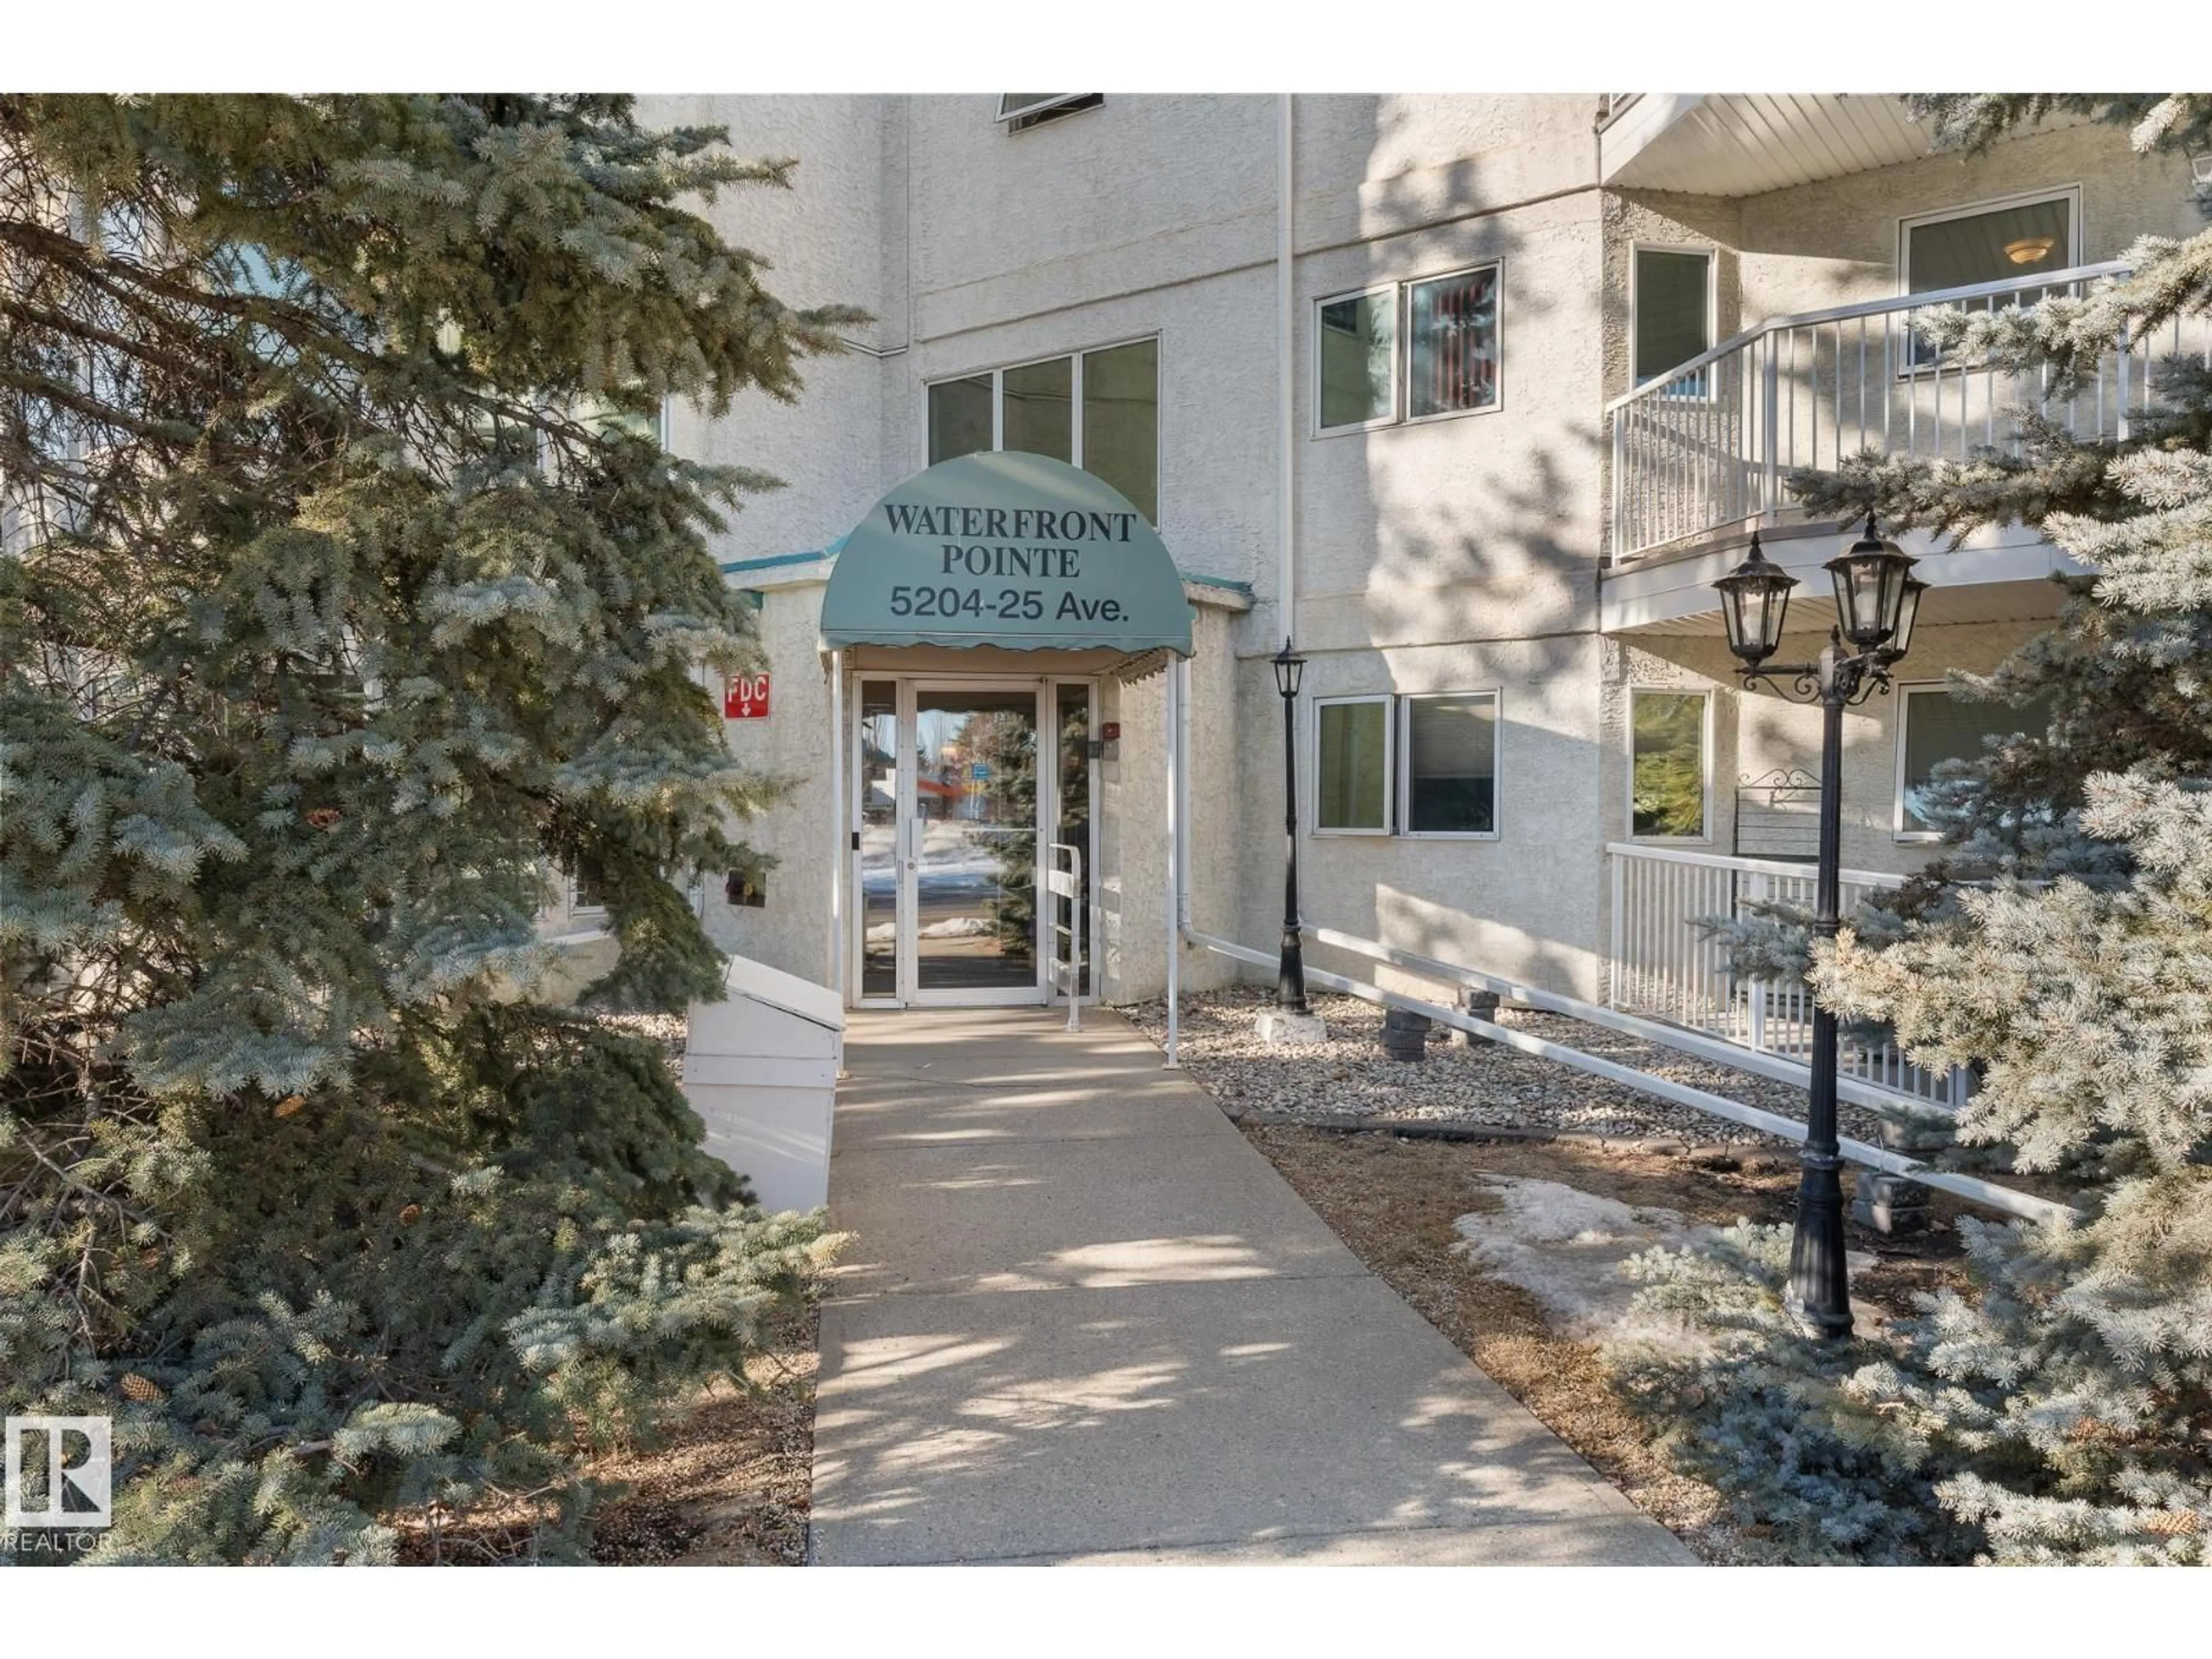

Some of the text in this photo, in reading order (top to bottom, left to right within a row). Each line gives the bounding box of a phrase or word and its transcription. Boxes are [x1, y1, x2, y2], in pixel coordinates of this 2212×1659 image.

[884, 504, 1137, 541] WATERFRONT
[940, 544, 1081, 578] POINTE
[889, 586, 1129, 622] 5204-25 Ave.
